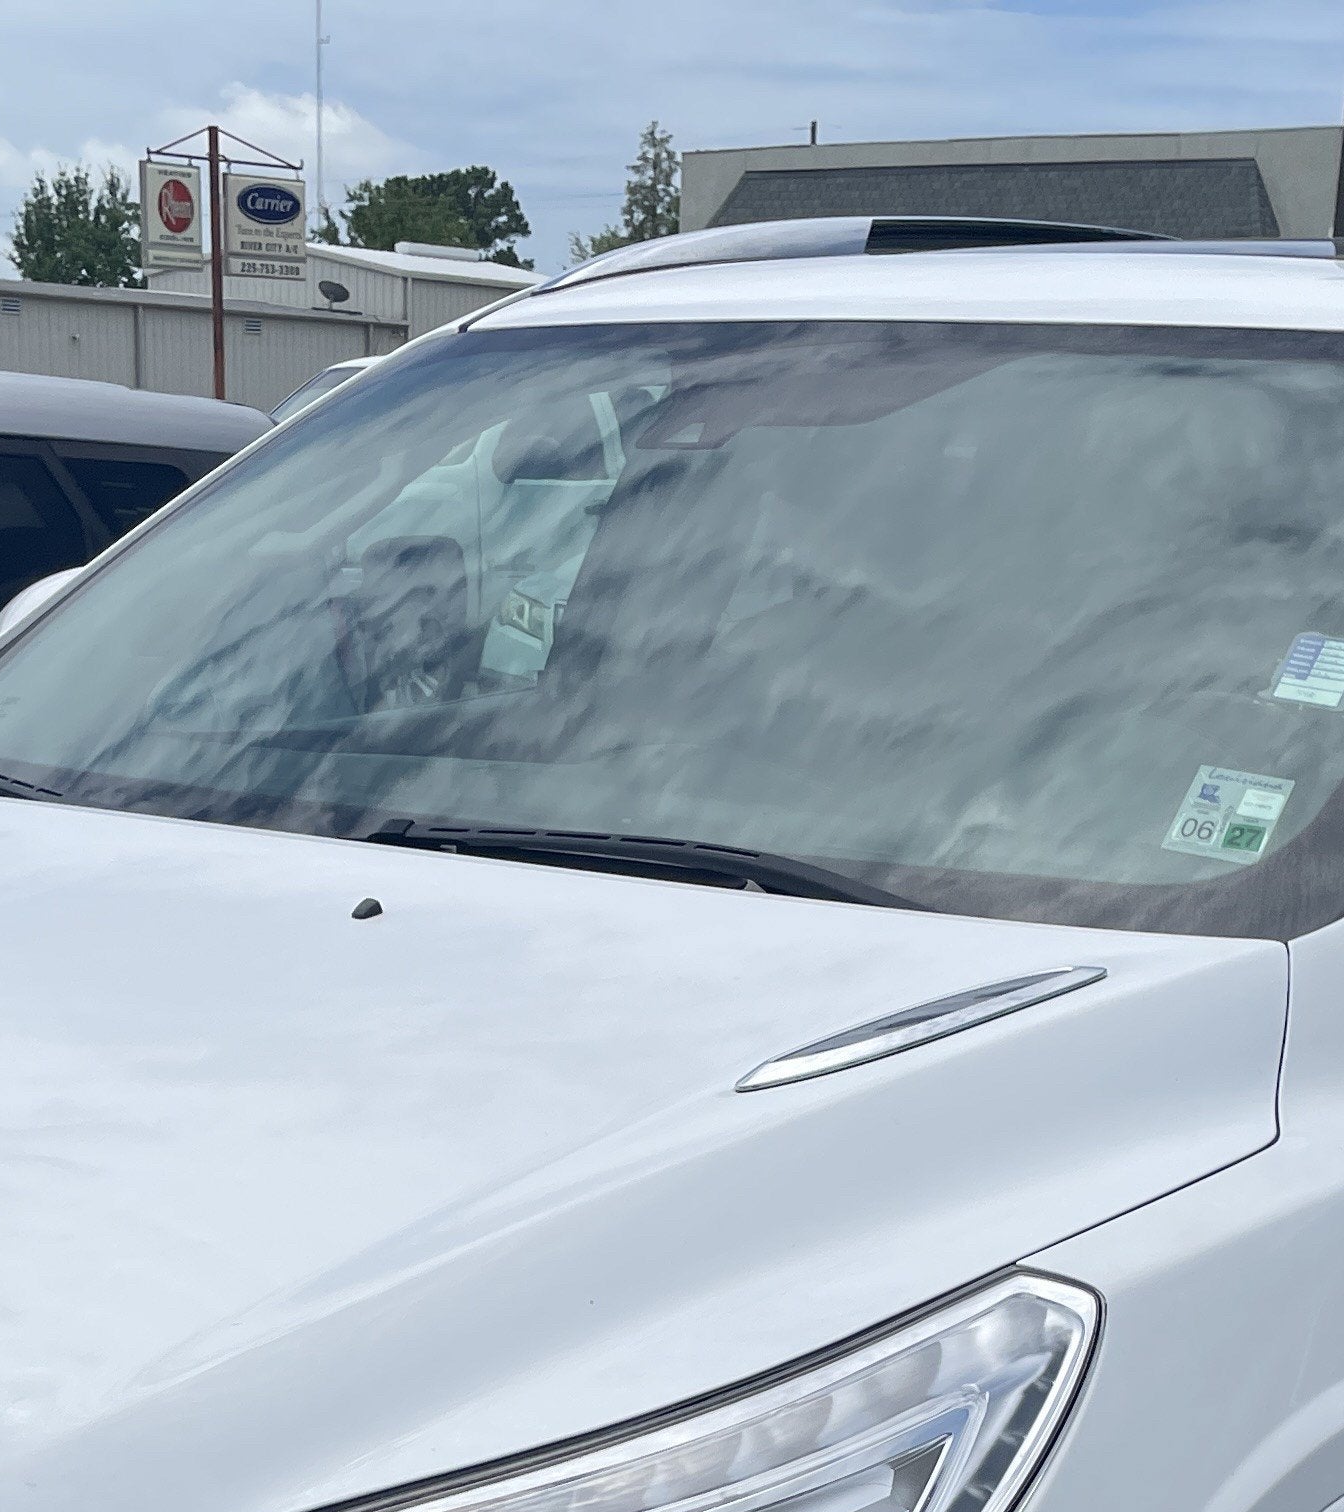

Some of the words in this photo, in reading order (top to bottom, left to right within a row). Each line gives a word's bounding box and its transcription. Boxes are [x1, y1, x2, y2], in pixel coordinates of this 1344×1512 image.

[246, 192, 294, 213] Carrier
[1180, 817, 1215, 841] 06
[1225, 826, 1263, 848] 27
